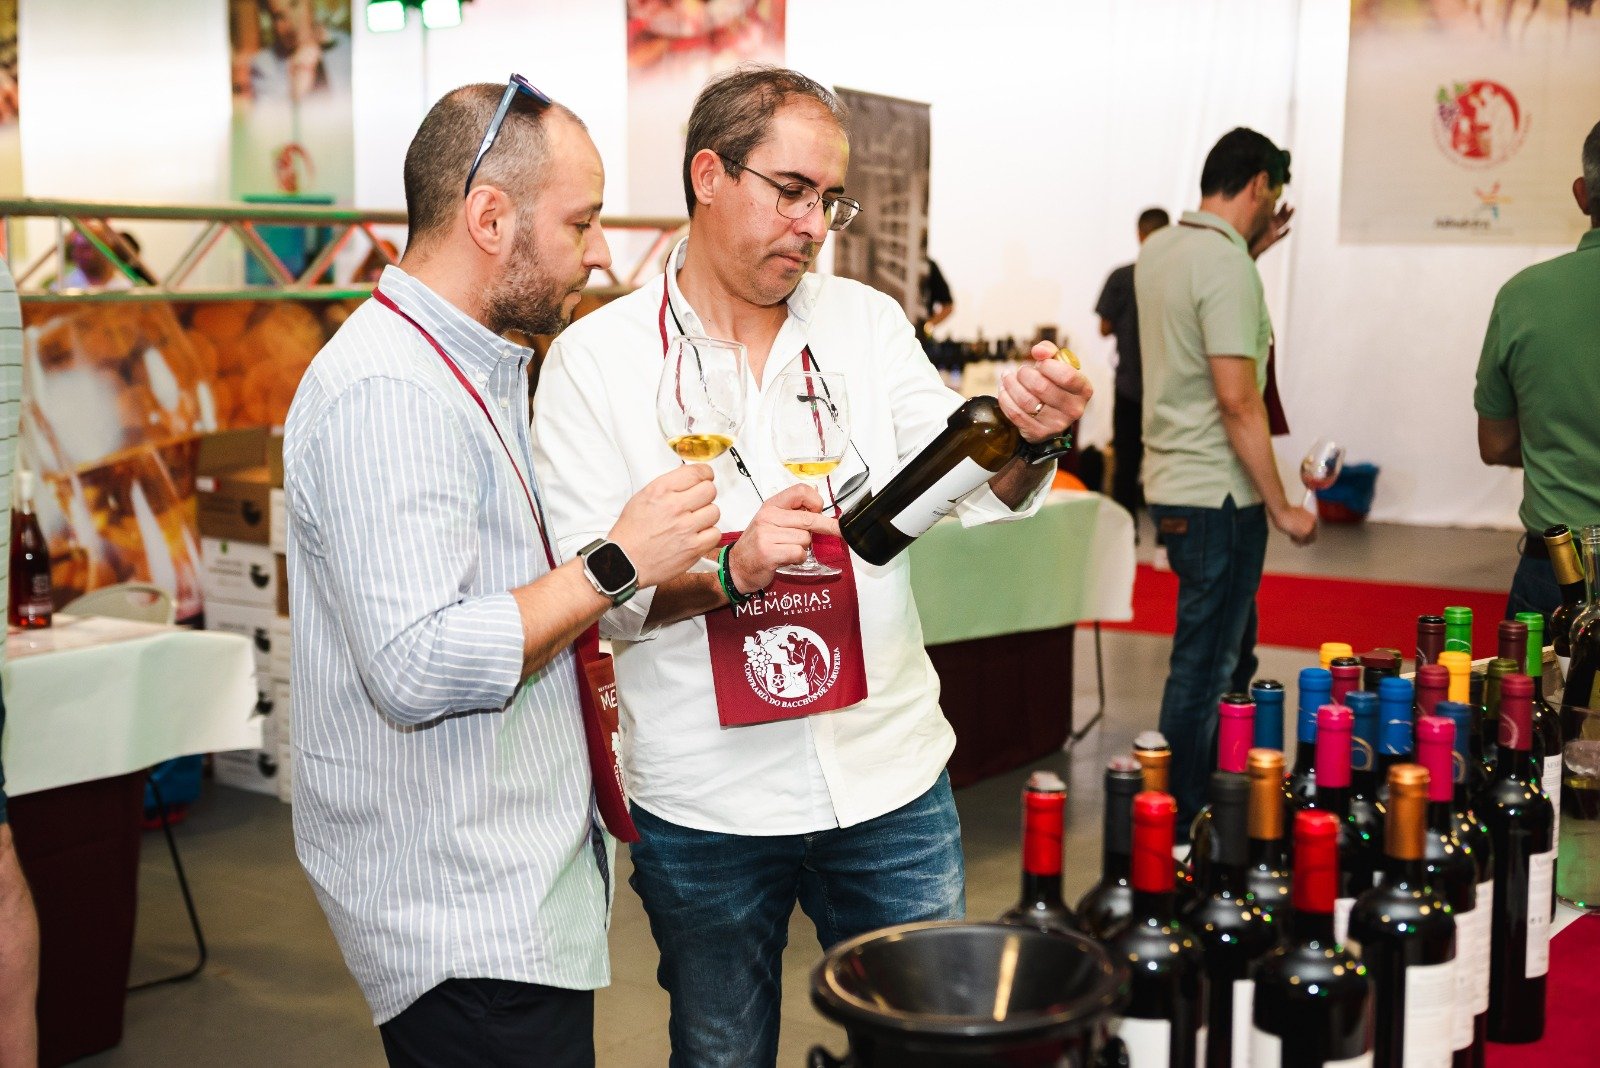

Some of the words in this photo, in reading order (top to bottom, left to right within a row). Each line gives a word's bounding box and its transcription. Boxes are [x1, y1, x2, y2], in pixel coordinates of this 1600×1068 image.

[736, 589, 831, 618] MEMÓRIAS
[768, 697, 781, 707] DO
[781, 693, 819, 708] BACCHUS
[817, 687, 828, 698] DE
[828, 646, 841, 689] ALBUFEIRA
